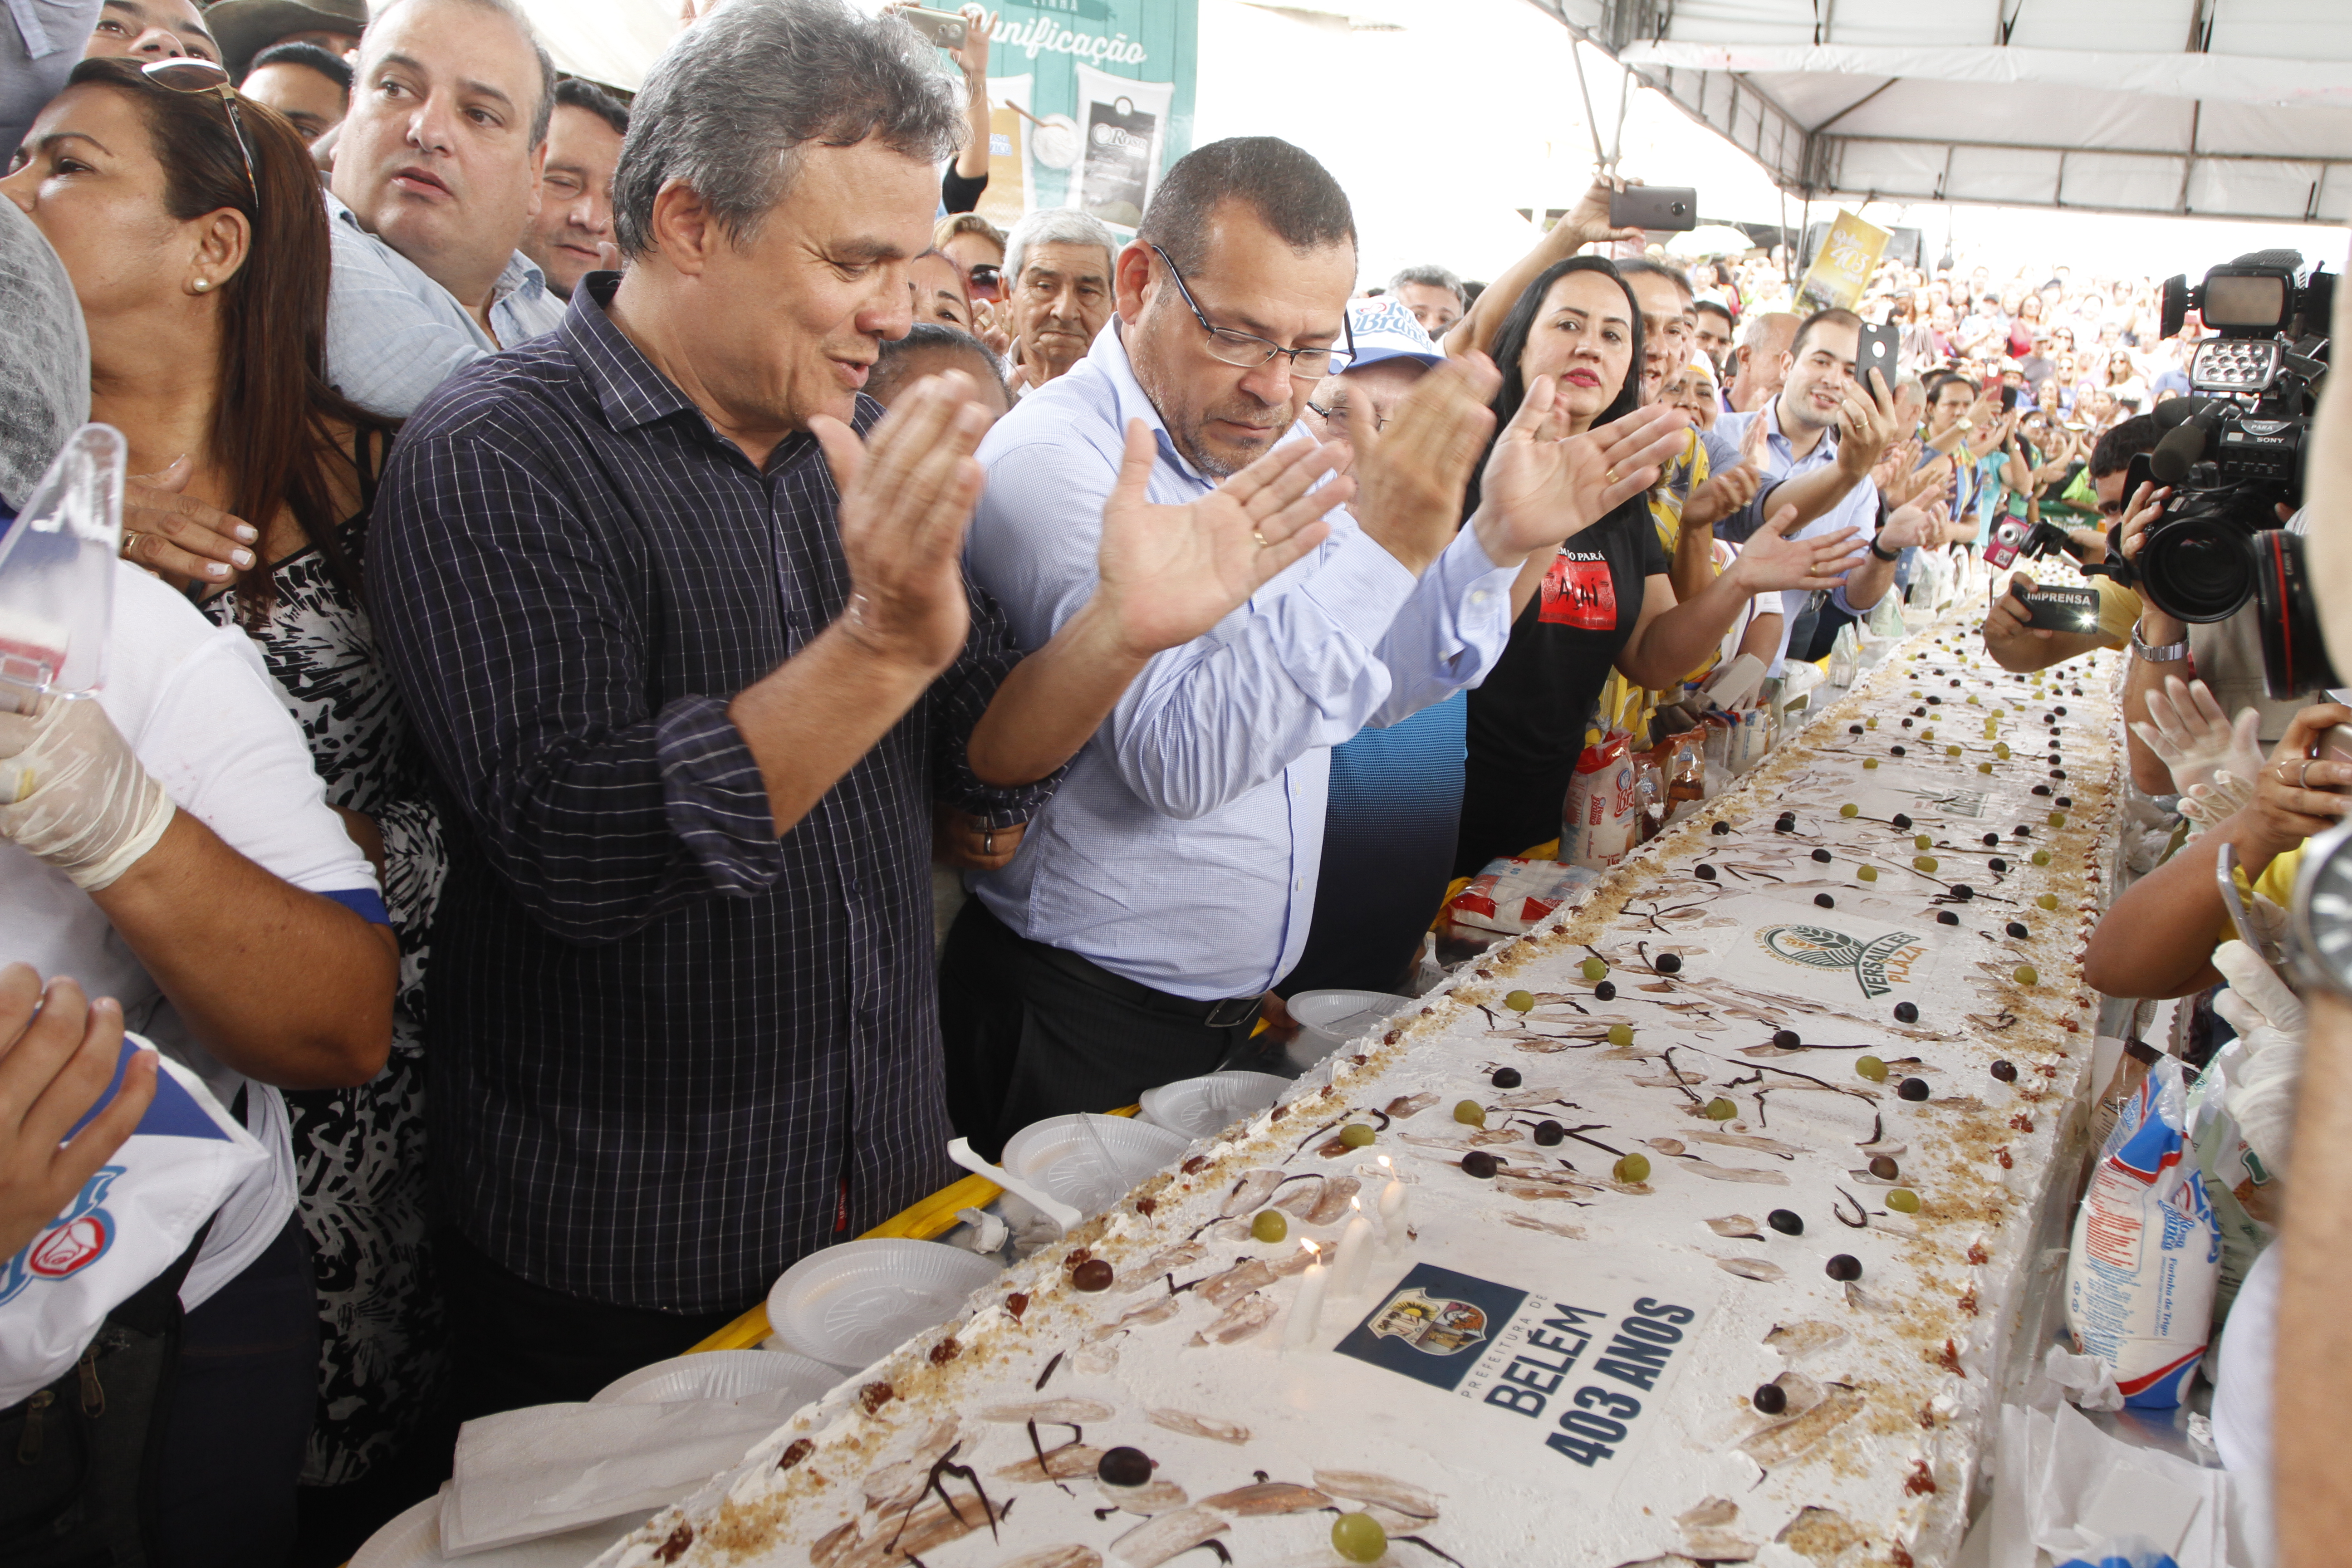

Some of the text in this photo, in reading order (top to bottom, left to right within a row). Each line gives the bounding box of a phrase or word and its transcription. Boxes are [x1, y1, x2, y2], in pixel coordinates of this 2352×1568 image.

[1830, 247, 1871, 274] 403
[1353, 313, 1432, 351] Branca
[1577, 550, 1606, 561] PARÁ
[2027, 593, 2091, 605] IMPRENSA
[1862, 934, 1921, 996] VERSAILLES
[1887, 946, 1929, 983] PLAZA
[2161, 1257, 2177, 1336] Farinha de Trigo
[1461, 1294, 1548, 1398] PREFEITURA DE
[1484, 1303, 1608, 1419] BELÉM
[1545, 1297, 1695, 1468] 403 ANOS
